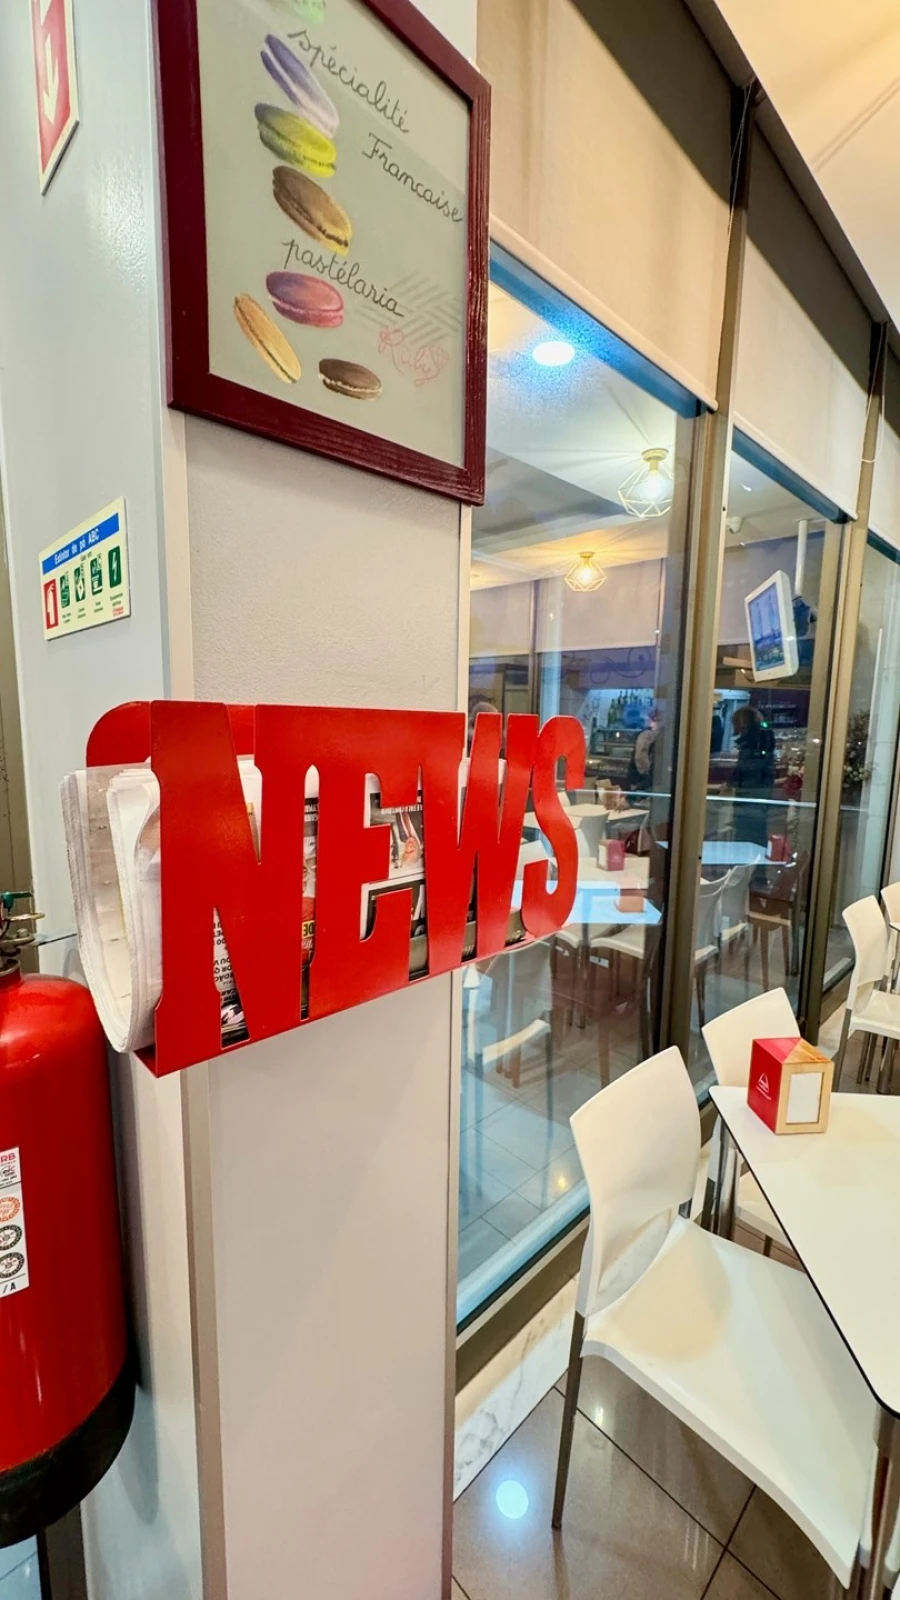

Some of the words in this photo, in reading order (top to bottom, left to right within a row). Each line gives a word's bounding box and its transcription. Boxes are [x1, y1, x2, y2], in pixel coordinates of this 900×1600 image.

[287, 28, 410, 135] spécialité
[361, 132, 464, 223] Francaise
[281, 236, 406, 318] pastélaria
[88, 528, 100, 544] ABC
[150, 698, 585, 1078] NEWS
